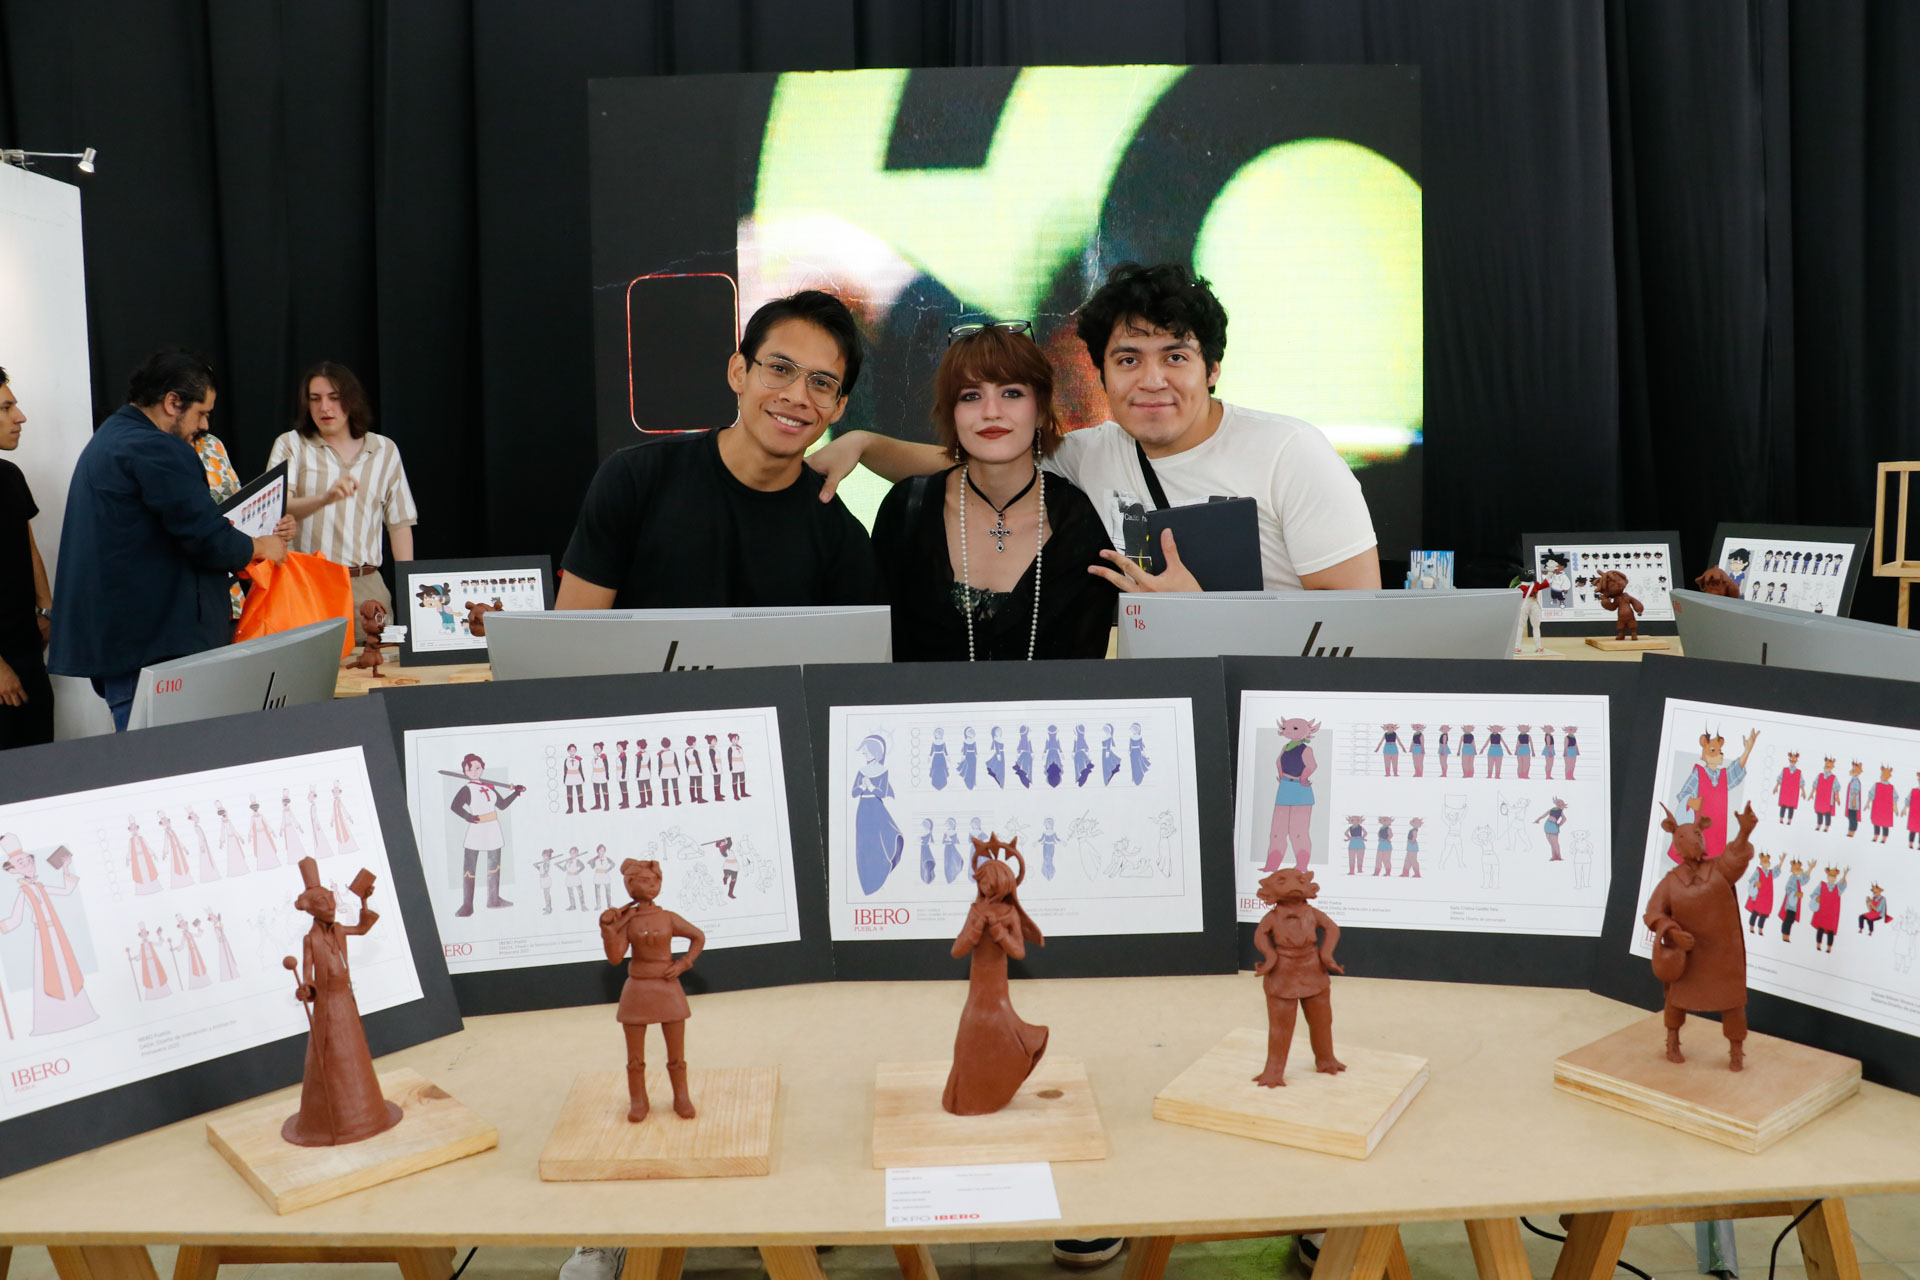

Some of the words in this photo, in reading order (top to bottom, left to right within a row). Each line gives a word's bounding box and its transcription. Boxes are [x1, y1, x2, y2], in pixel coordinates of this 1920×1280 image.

[1134, 618, 1146, 630] 18
[156, 678, 183, 694] G110
[854, 907, 910, 925] IBERO
[443, 943, 473, 957] ERO
[11, 1058, 70, 1087] IBERO
[891, 1215, 931, 1223] EXPO
[934, 1213, 980, 1221] IBERO
